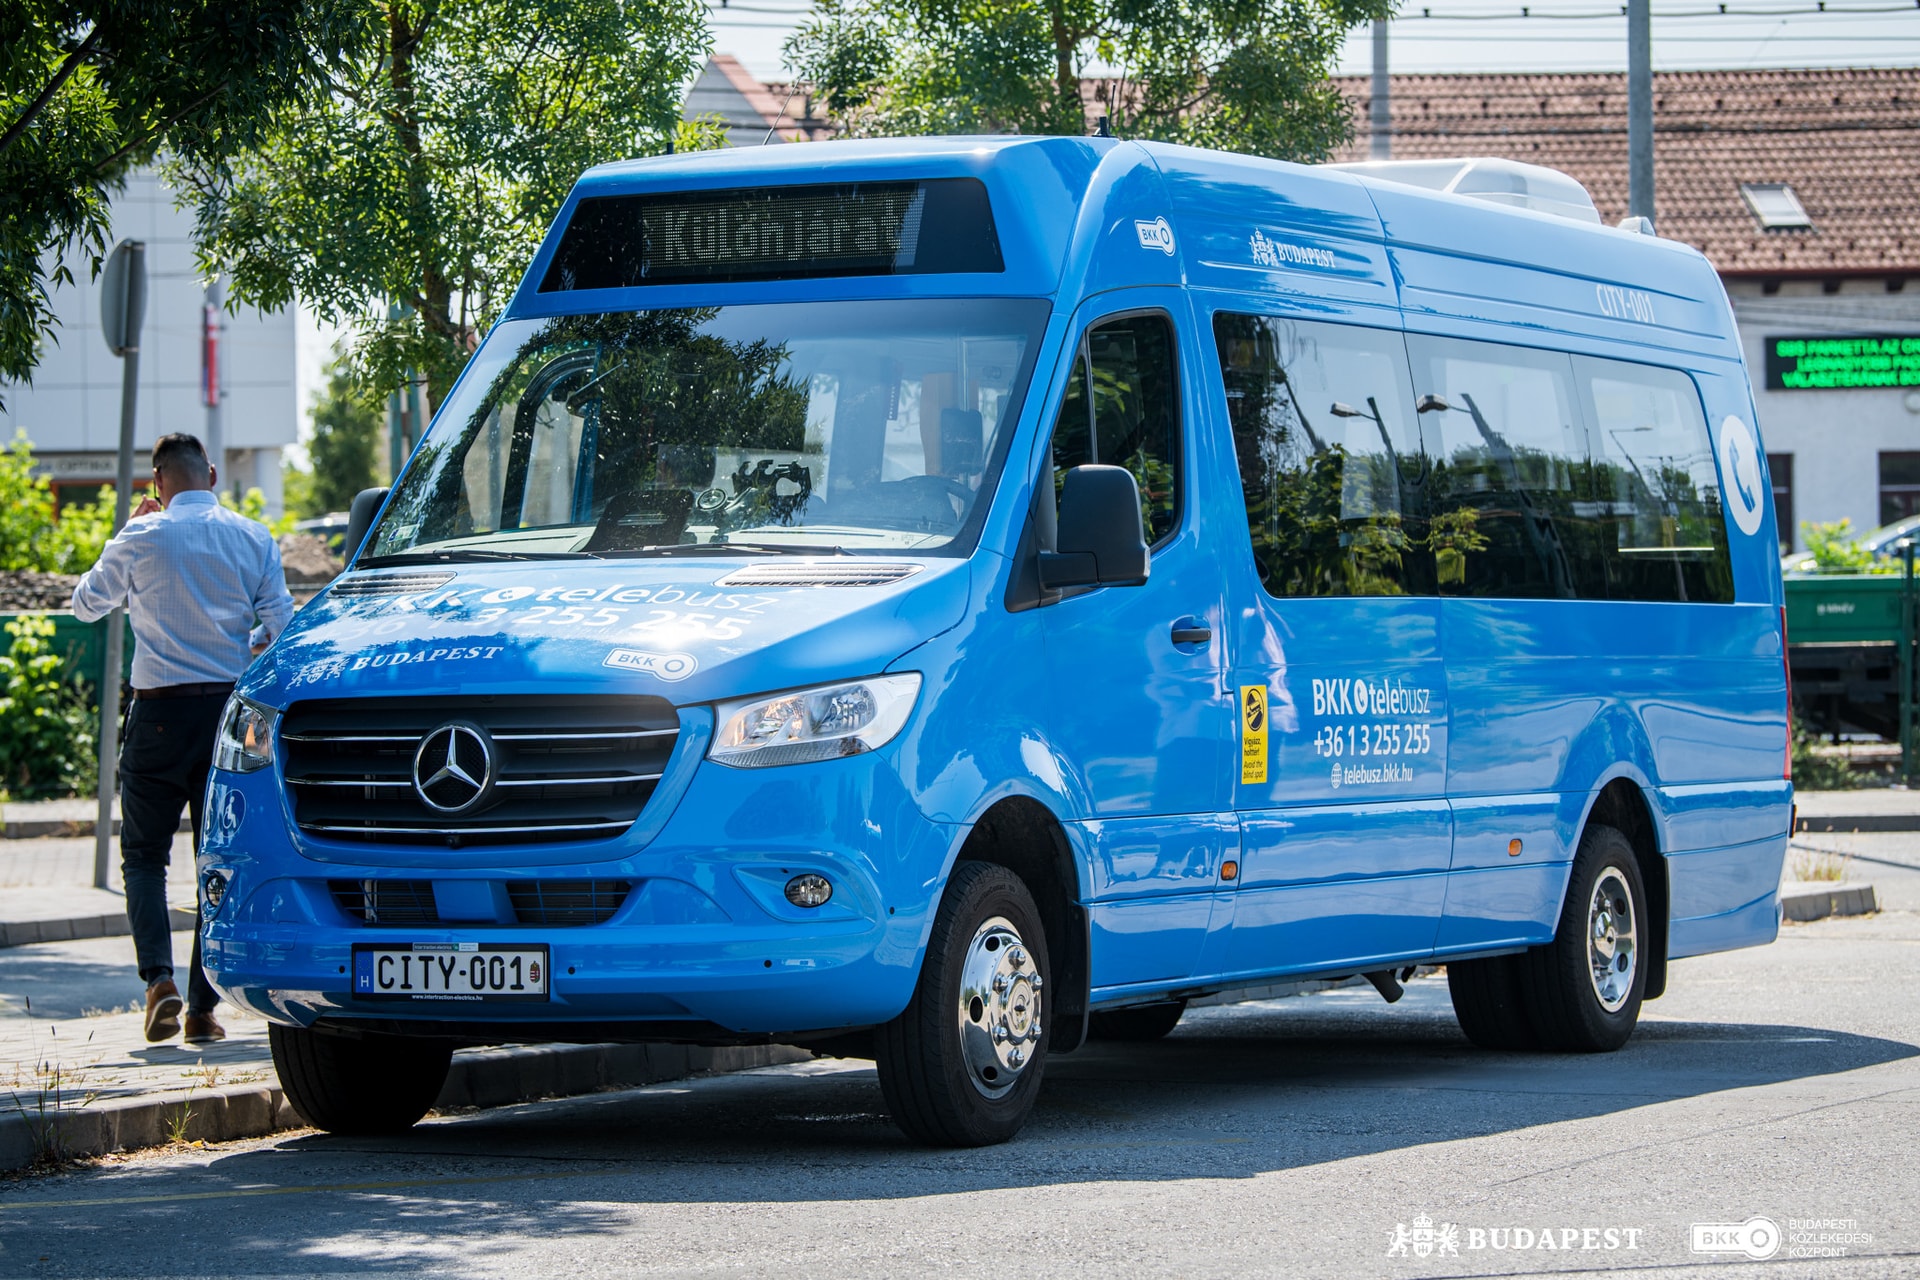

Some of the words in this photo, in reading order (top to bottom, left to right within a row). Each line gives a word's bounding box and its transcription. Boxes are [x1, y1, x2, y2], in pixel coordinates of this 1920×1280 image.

[665, 199, 901, 261] Különjárat
[1140, 228, 1159, 242] BKK
[1276, 242, 1337, 269] BUDAPEST
[1596, 284, 1656, 324] CITY-001
[536, 584, 780, 614] telebusz
[464, 607, 509, 626] 3
[512, 606, 630, 626] 255
[632, 609, 752, 640] 255
[350, 646, 505, 671] BUDAPEST
[617, 653, 657, 668] BKK
[1312, 679, 1352, 716] BKK
[1369, 679, 1430, 715] telebusz
[1313, 725, 1344, 758] +36
[1348, 725, 1356, 756] 1
[1360, 725, 1370, 756] 3
[1373, 724, 1400, 756] 255
[1403, 724, 1430, 755] 255
[1344, 762, 1413, 785] telebusz.bkk.hu
[360, 975, 369, 988] H
[378, 955, 525, 990] CITY-001
